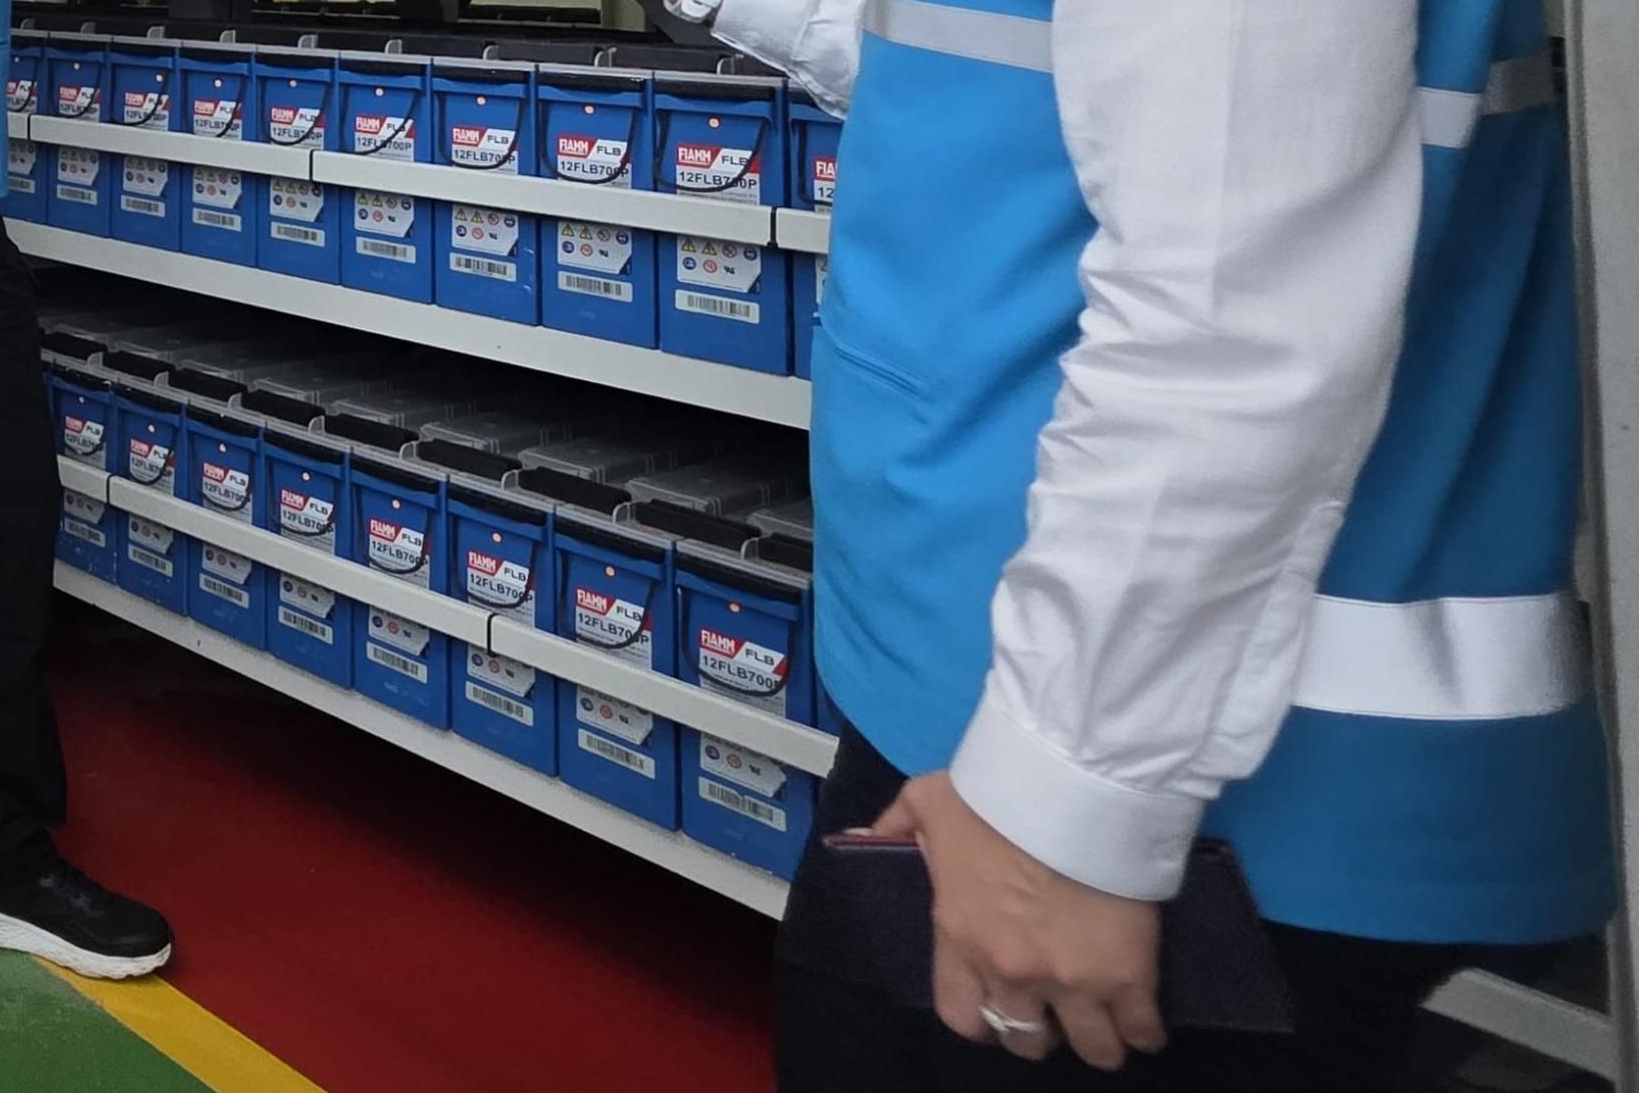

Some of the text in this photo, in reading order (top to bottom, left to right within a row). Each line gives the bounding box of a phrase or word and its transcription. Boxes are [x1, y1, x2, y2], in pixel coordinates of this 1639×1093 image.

[487, 135, 509, 145] FLB
[559, 138, 621, 156] FIAMM FLB
[678, 146, 746, 166] FIAMM FLB
[816, 161, 835, 178] FIA
[504, 567, 526, 582] FLB
[576, 589, 642, 621] FIAMM FLB
[701, 630, 774, 666] FIAMM FLB
